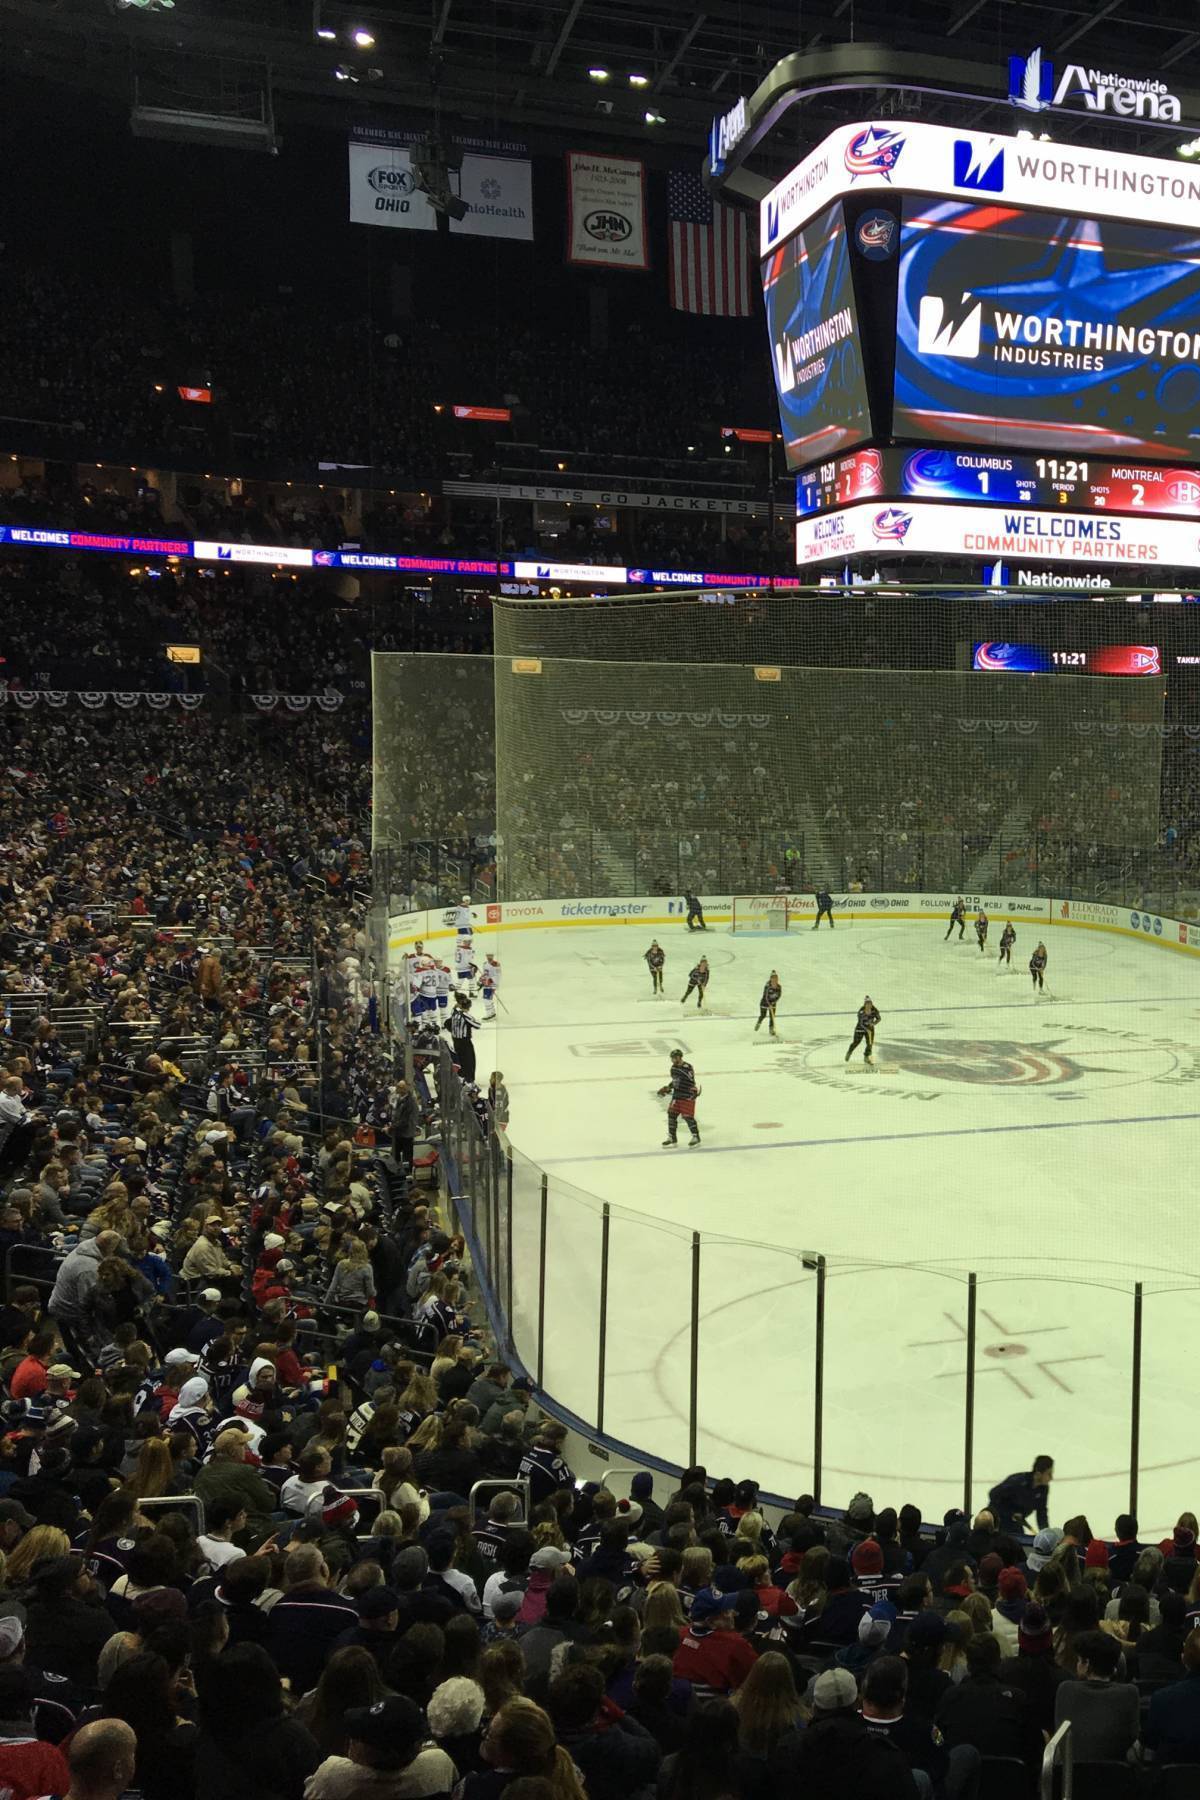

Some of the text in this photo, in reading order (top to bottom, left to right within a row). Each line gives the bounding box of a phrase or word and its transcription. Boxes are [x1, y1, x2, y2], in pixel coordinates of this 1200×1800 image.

[1089, 69, 1167, 94] Nationwide
[1052, 64, 1181, 122] Arena
[378, 171, 406, 186] FOX
[781, 155, 829, 214] WORTHINGTON
[375, 197, 409, 213] OHIO
[793, 307, 852, 365] WORTHINGTON
[994, 346, 1104, 371] INDUSTRIES
[957, 455, 1165, 482] COLUMBUS 11:21 MONTREAL
[978, 472, 988, 494] 1
[1016, 480, 1110, 494] SHOTS PERIOD SHOTS
[519, 487, 748, 512] LET'S GO JACKETS
[1060, 492, 1068, 504] 3
[1131, 484, 1145, 506] 2
[814, 516, 844, 540] WELCOMES
[1005, 515, 1121, 541] WELCOMES
[11, 529, 188, 553] WELCOMES COMMUNITY PARTNERS
[964, 534, 1158, 560] COMMUNITY PARTNERS
[341, 554, 396, 567] WELCOMES
[398, 558, 456, 571] COMMUNITY
[652, 571, 799, 588] WELCOMES COMMUNITY PARTNER
[1018, 570, 1111, 588] Nationwide
[1052, 653, 1086, 665] 11:21
[505, 907, 544, 917] TOYOTA
[561, 902, 646, 916] ticketmaster
[687, 903, 732, 912] ionwide
[921, 899, 950, 908] FOLLOW
[1072, 903, 1119, 916] ELDORADO
